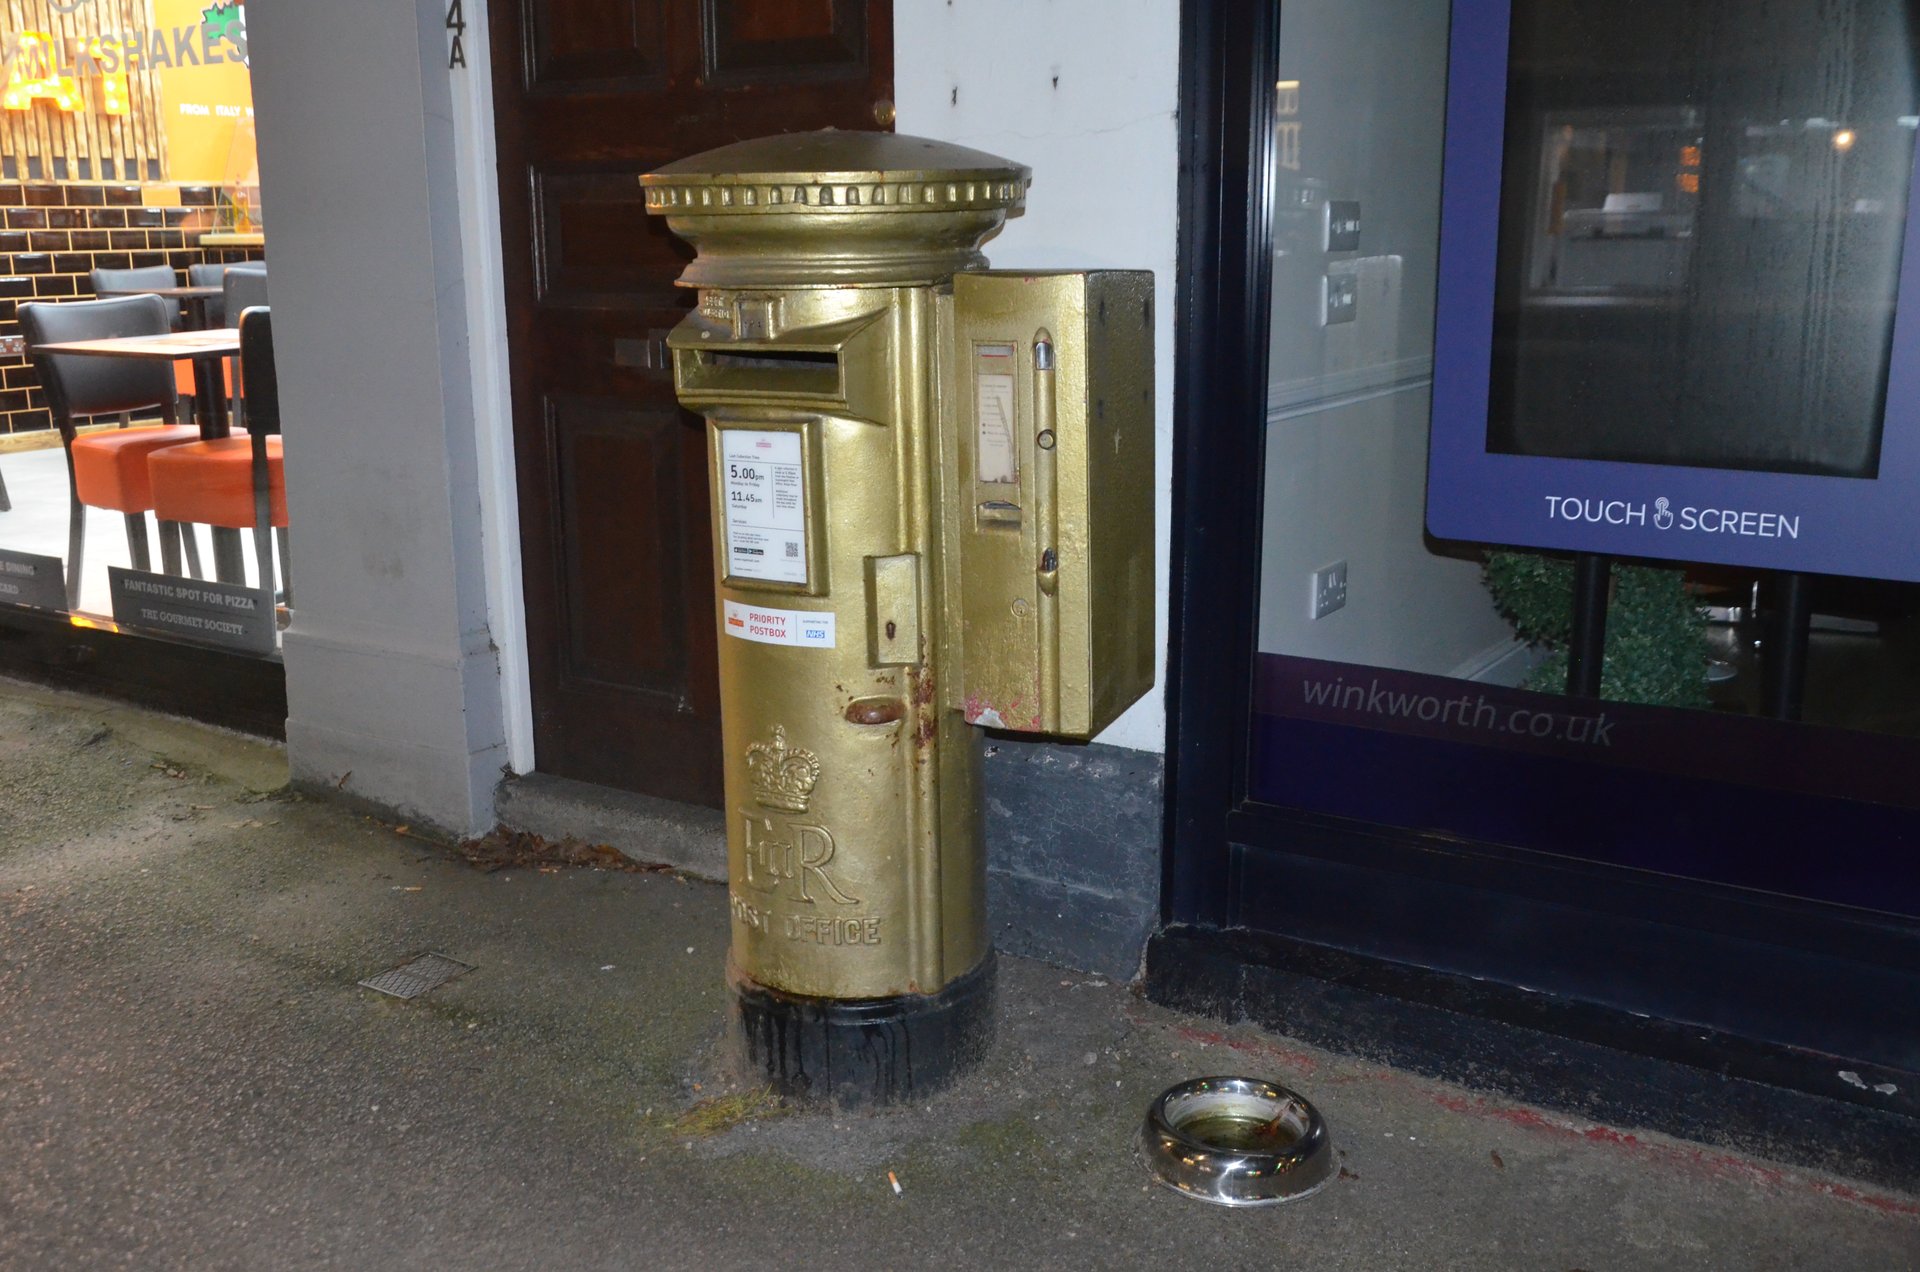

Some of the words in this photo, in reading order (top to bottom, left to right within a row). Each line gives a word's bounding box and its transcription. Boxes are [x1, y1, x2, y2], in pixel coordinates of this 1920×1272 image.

[17, 20, 248, 80] MILKSHAKES
[179, 103, 210, 116] FROM
[215, 104, 241, 117] ITALY
[730, 464, 765, 480] 5.00pm
[731, 490, 763, 503] 11.45am
[1545, 495, 1647, 526] TOUCH
[1679, 506, 1800, 539] SCREEN
[175, 587, 201, 601] SPOT
[202, 591, 223, 606] FOR
[141, 608, 159, 621] THE
[160, 611, 203, 628] GOURMET
[204, 619, 244, 635] SOCIETY
[749, 612, 786, 625] PRIORITY
[749, 625, 787, 638] POSTBOX
[806, 630, 825, 638] NHS
[1303, 676, 1617, 747] winkworth.co.uk
[785, 913, 882, 945] OFFICE
